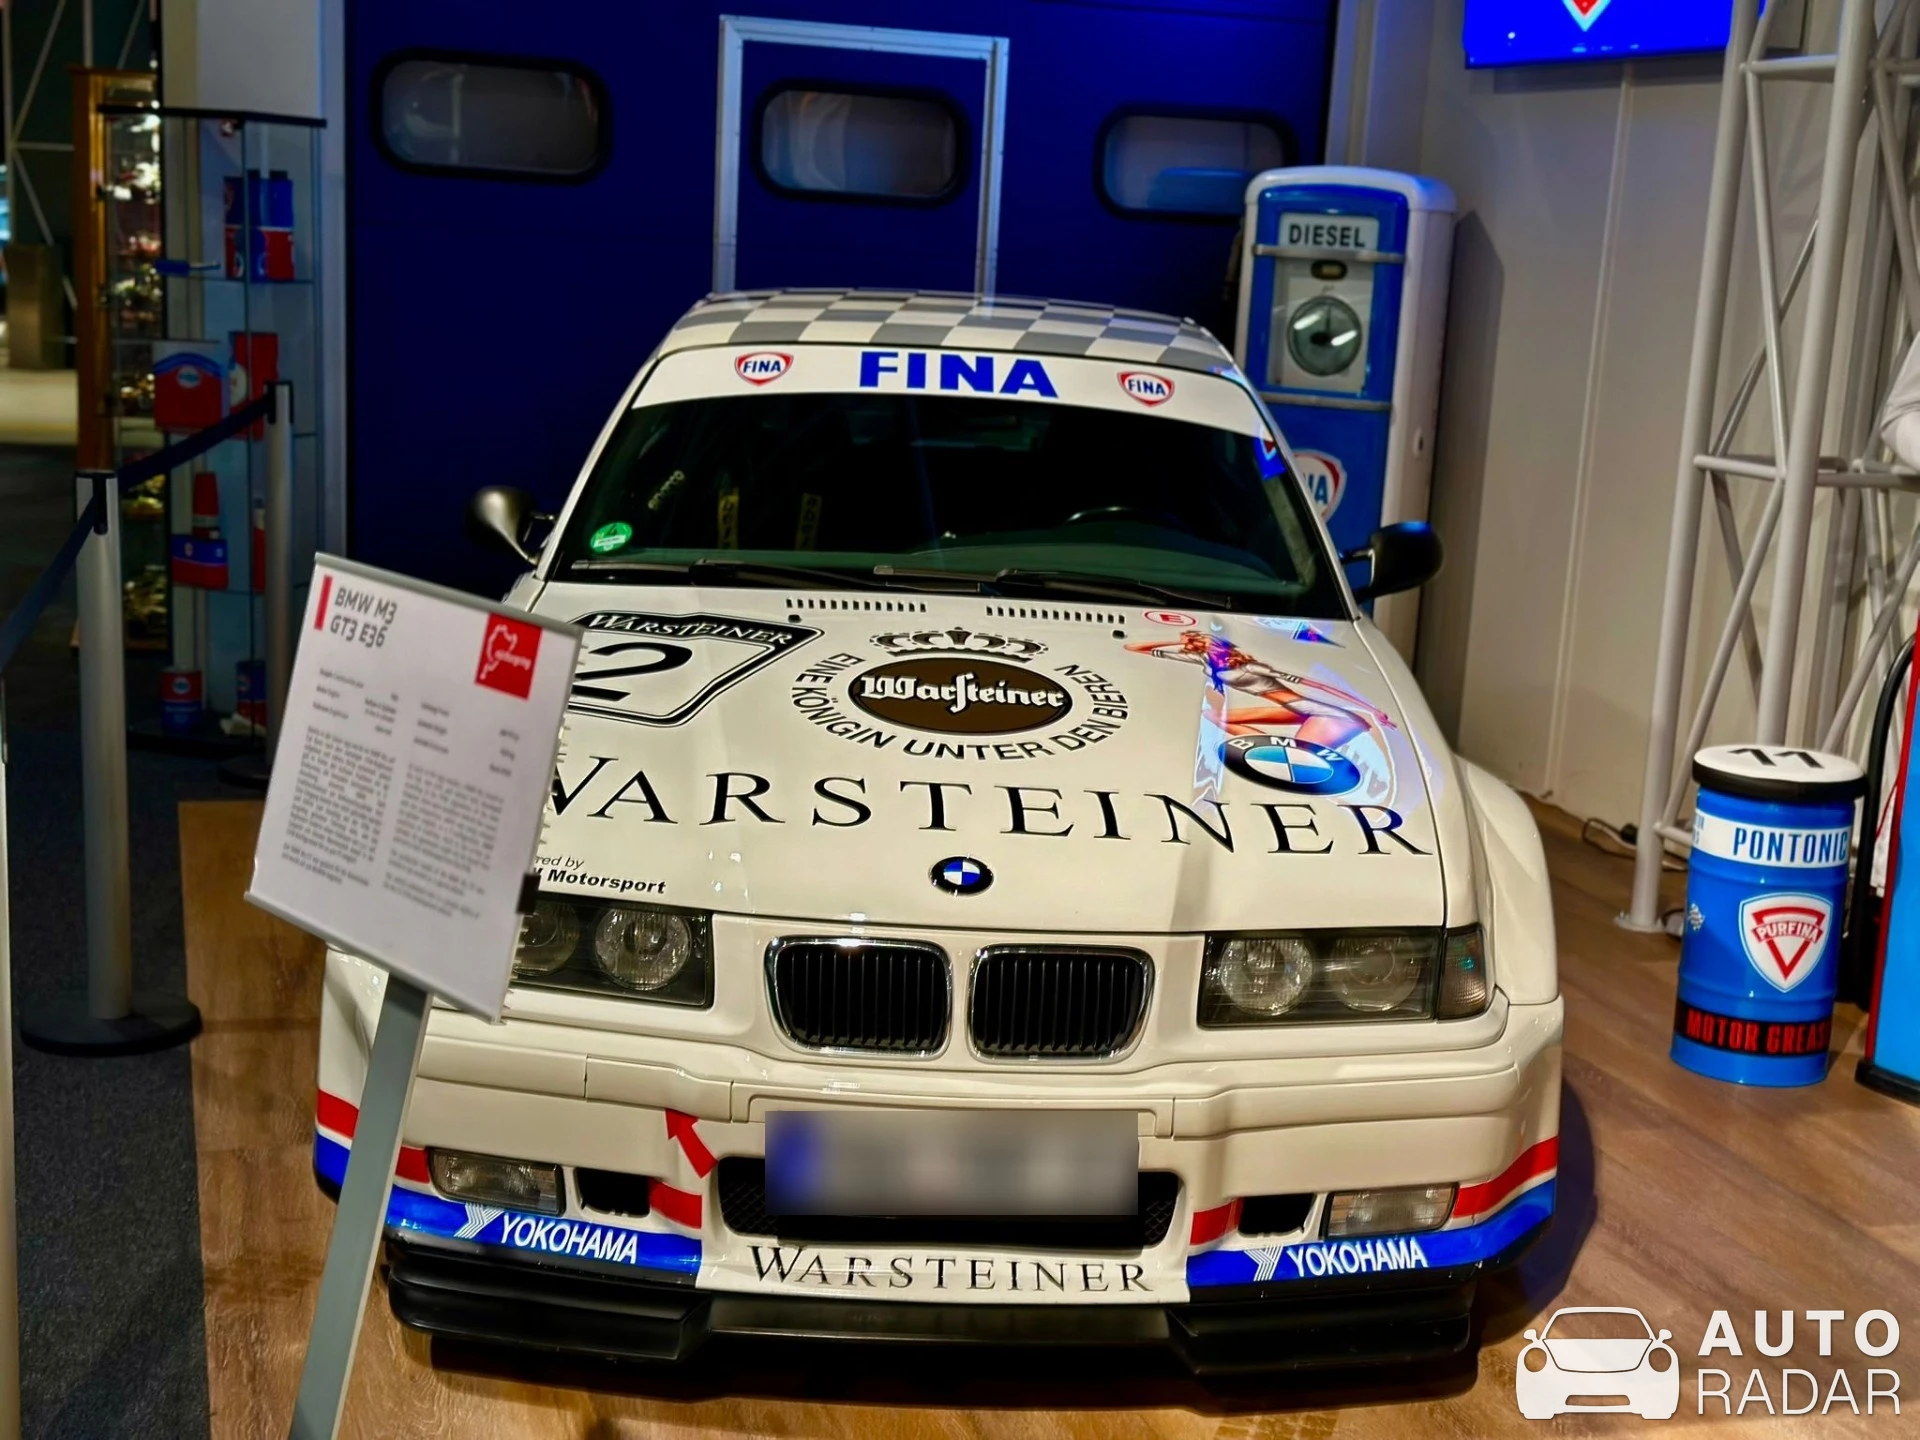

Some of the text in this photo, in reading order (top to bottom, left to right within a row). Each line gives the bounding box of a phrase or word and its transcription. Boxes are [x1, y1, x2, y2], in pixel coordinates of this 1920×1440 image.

[1288, 223, 1366, 249] DIESEL
[742, 360, 782, 374] FINA
[860, 351, 1058, 399] FINA
[1127, 378, 1167, 397] FINA
[334, 587, 398, 626] BMW M3
[330, 614, 389, 649] GT3 E36
[588, 614, 793, 645] WARSTEINER
[571, 641, 693, 702] 2
[791, 652, 1130, 761] EINE KÖNIGIN UNTER DEN BIEREN
[564, 856, 585, 871] by
[1732, 826, 1849, 864] PONTONIC
[547, 868, 667, 895] Motorsport
[1755, 920, 1820, 942] PURFINA
[1686, 1008, 1827, 1055] MOTOR GREAS
[500, 1212, 639, 1265] YOKOHAMA
[1286, 1235, 1429, 1278] YOKOHAMA
[747, 1243, 1155, 1293] WARSTEINER
